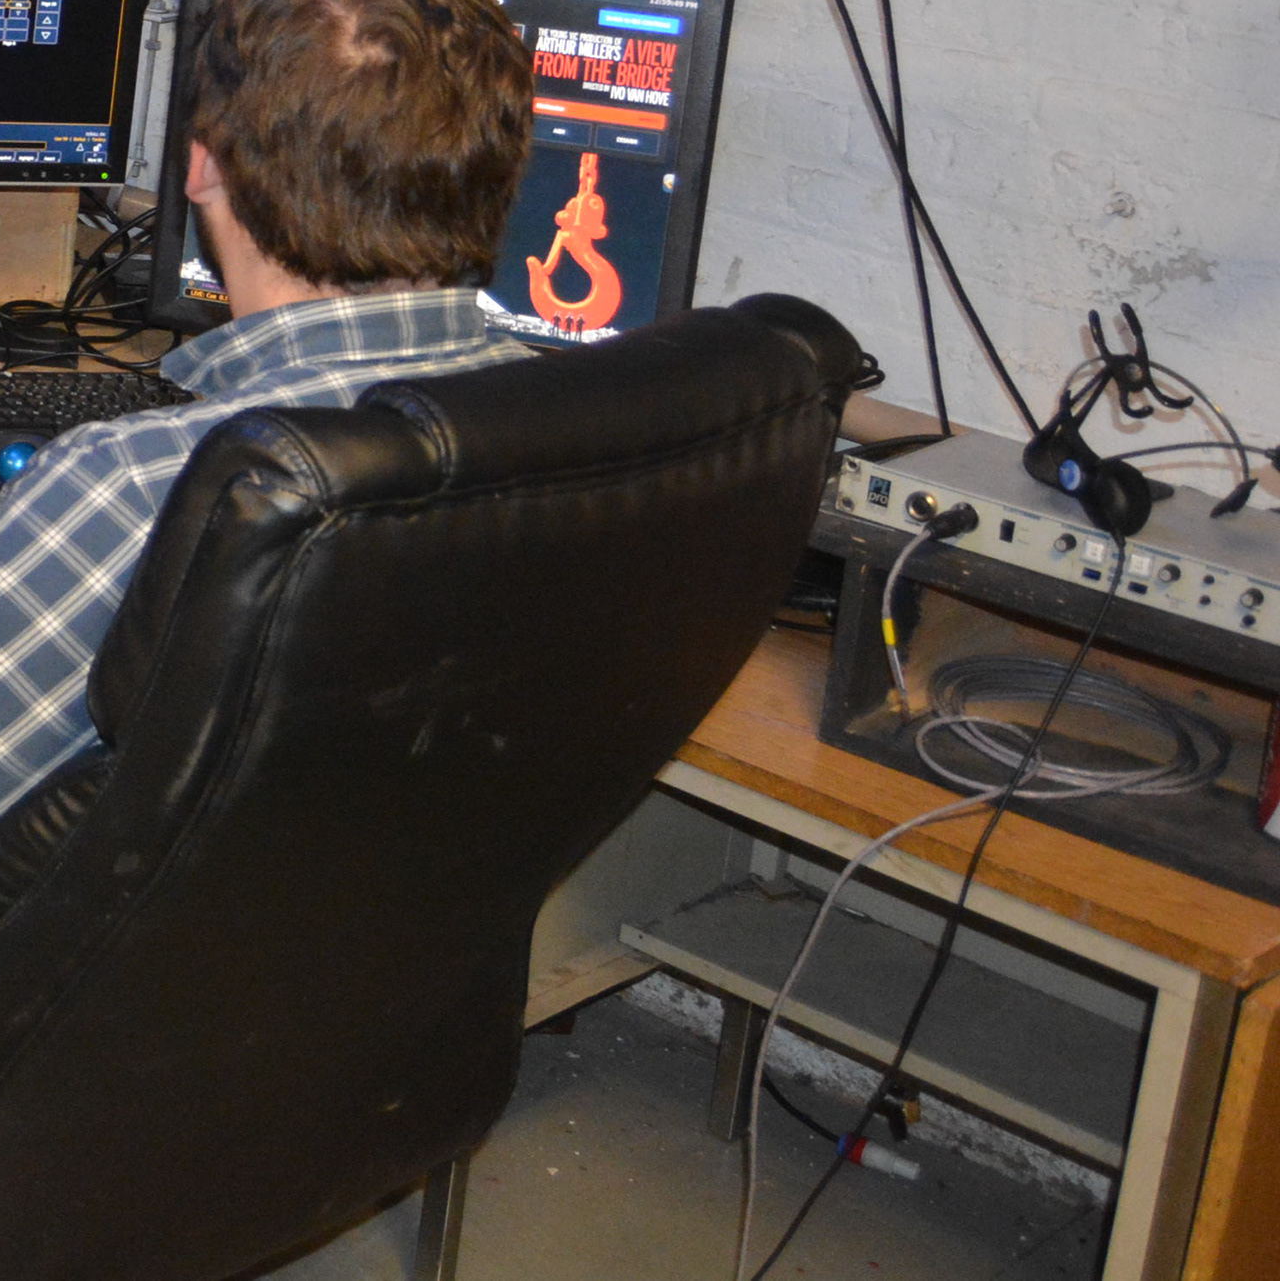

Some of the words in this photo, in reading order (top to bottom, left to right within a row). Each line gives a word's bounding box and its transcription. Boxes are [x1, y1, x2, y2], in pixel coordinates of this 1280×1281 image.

[685, 0, 698, 10] PM
[538, 27, 548, 37] THE
[549, 29, 567, 39] YOUNG
[579, 33, 613, 45] PRODUCTION
[535, 36, 577, 56] ARTHUR
[578, 42, 622, 62] MILLER'S
[622, 38, 635, 63] A
[637, 40, 678, 68] VIEW
[533, 51, 580, 80] FROM
[582, 57, 614, 85] THE
[616, 62, 674, 92] BRIDGE
[610, 86, 625, 100] IVO
[627, 88, 644, 103] VAN
[645, 90, 670, 106] HOVE
[870, 492, 887, 504] pro
